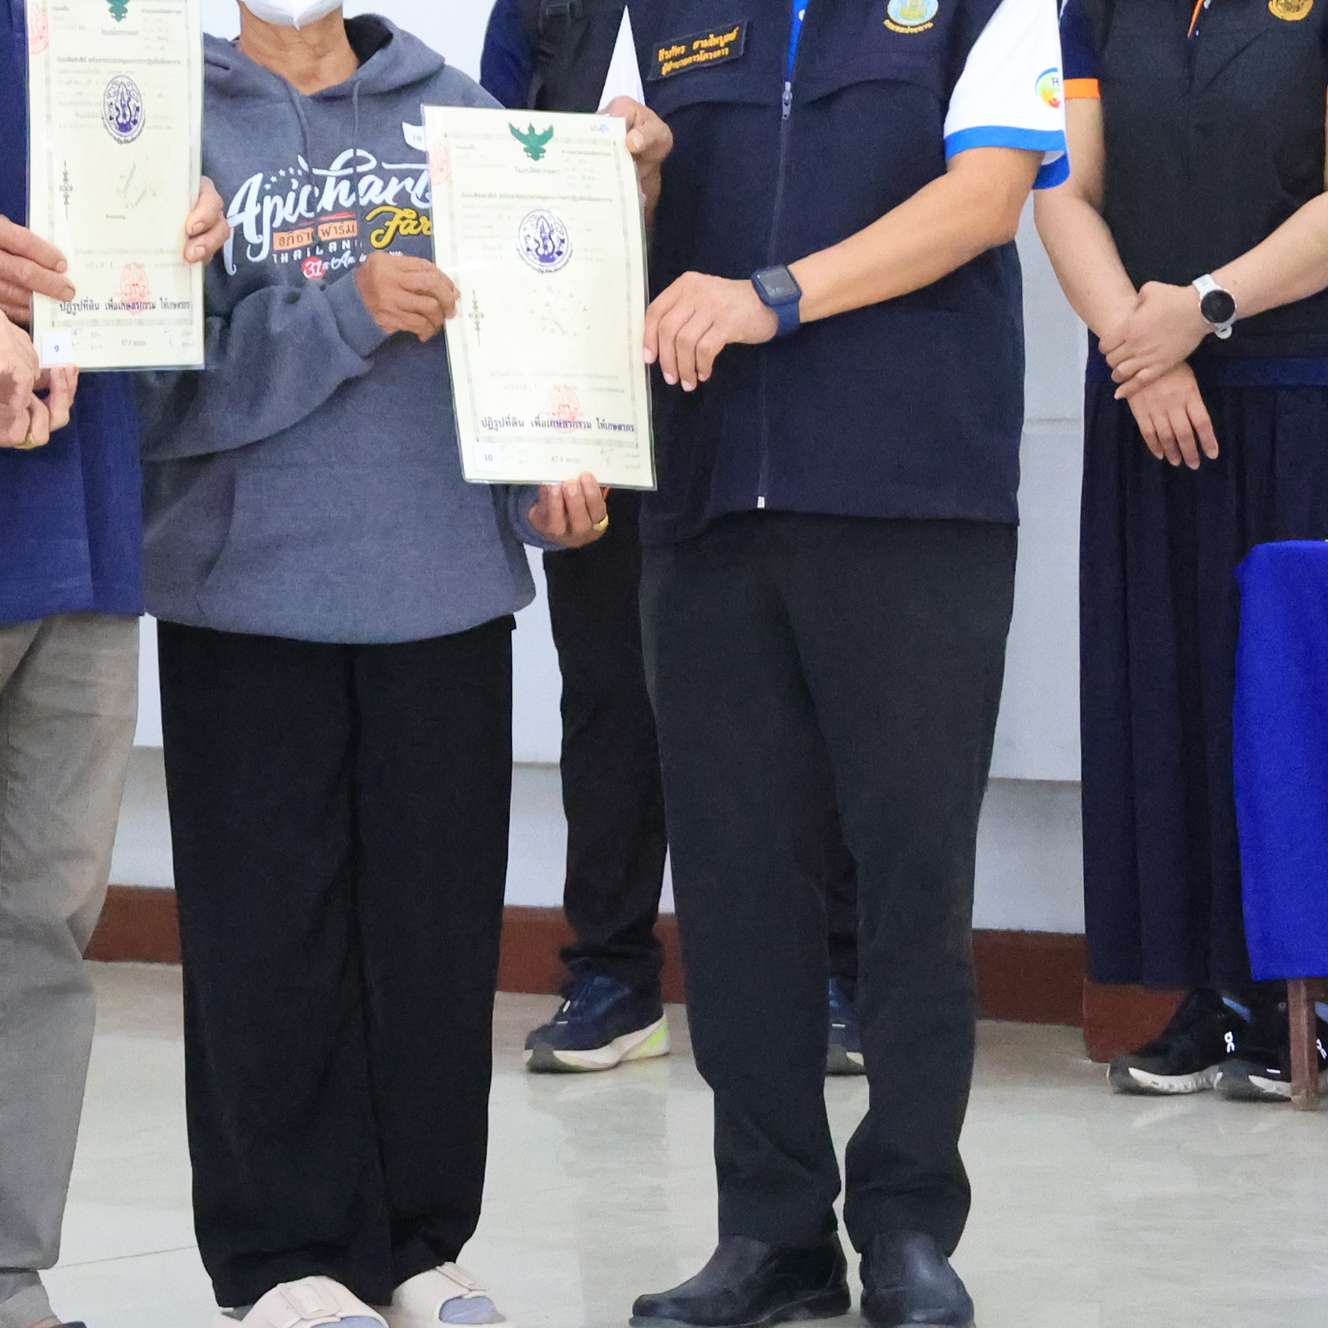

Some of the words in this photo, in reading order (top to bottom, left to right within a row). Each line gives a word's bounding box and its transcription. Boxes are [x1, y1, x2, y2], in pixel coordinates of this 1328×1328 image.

[320, 221, 356, 238] ฟาร์ม
[365, 205, 432, 249] Far
[59, 296, 100, 315] ปฏิรูปที่ดิน
[53, 344, 60, 353] 9
[481, 415, 525, 431] ปฏิรูปที่ดิน
[530, 414, 592, 430] เพื่อเกษตรกรรม
[483, 453, 494, 462] 10
